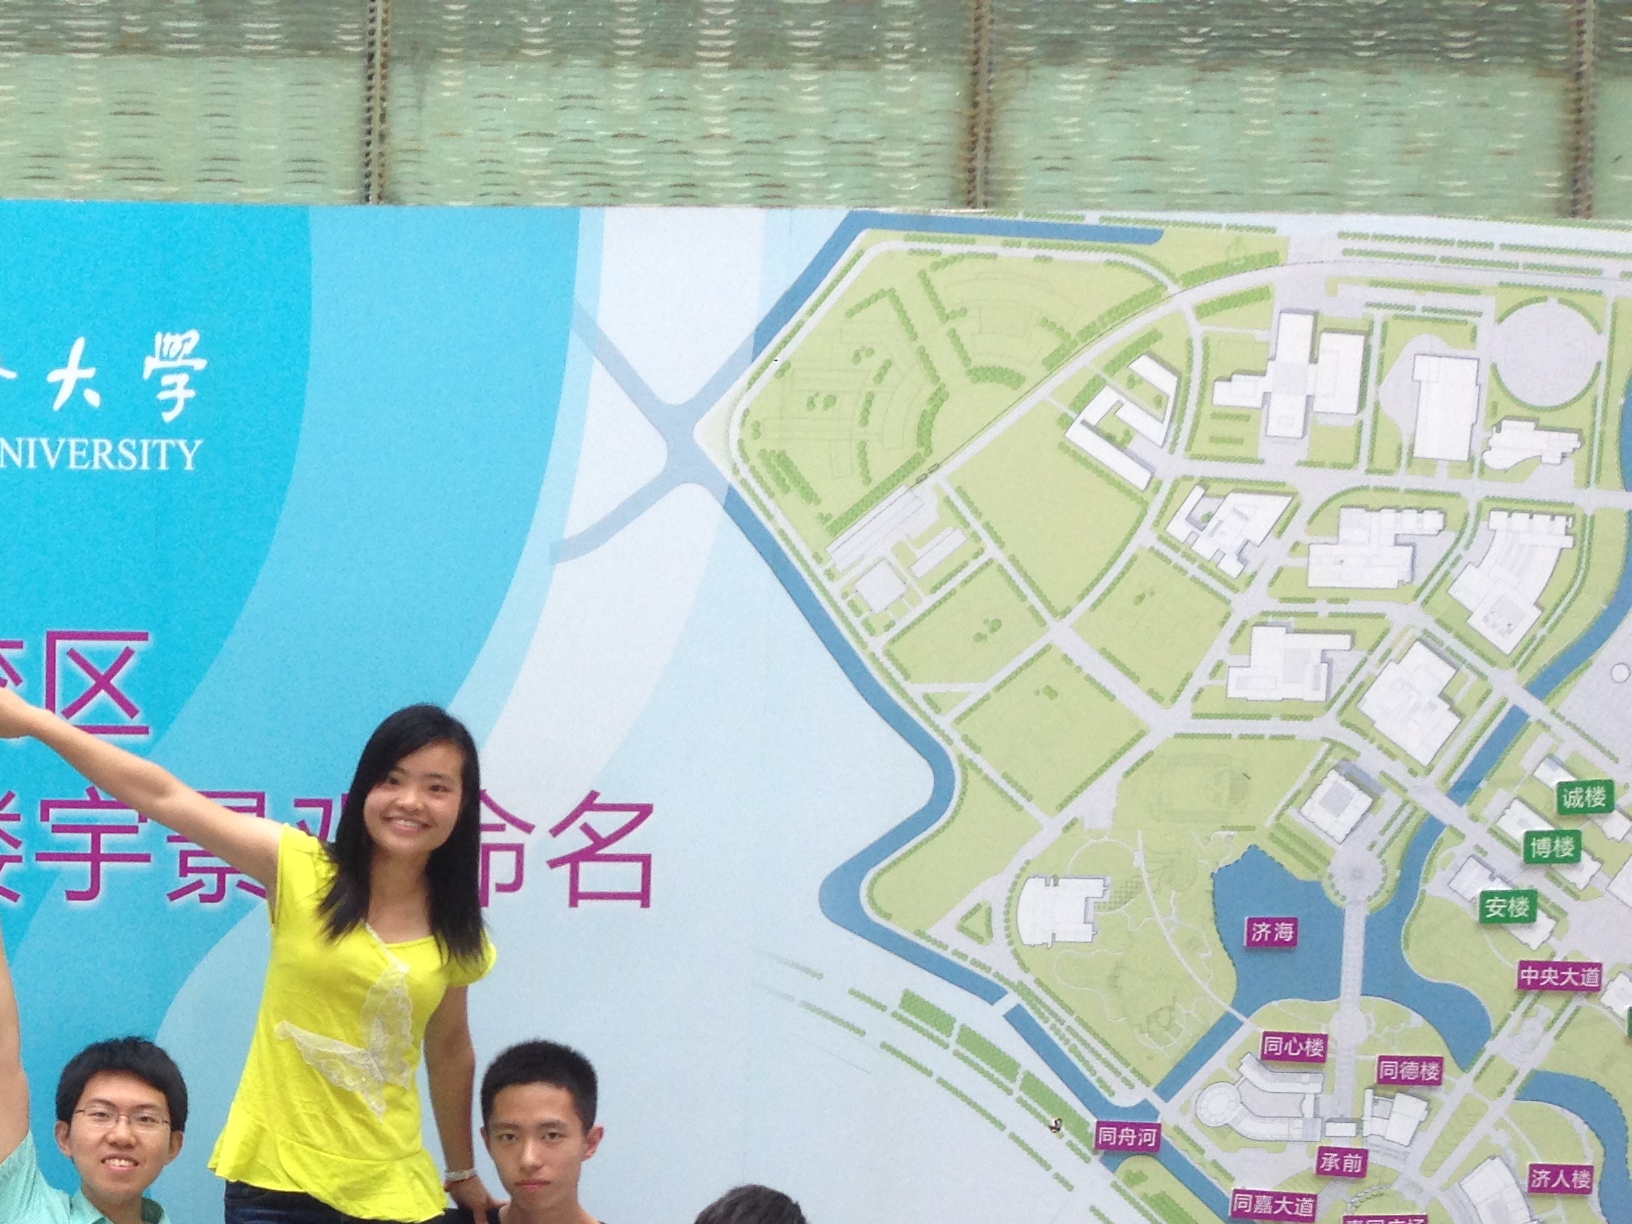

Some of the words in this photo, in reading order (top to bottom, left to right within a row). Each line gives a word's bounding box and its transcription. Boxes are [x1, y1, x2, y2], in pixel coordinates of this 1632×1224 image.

[1563, 786, 1607, 808] 诚楼
[1531, 836, 1576, 859] 博楼
[1485, 895, 1530, 918] 安楼
[1251, 921, 1295, 943] 济海
[1519, 966, 1601, 988] 中央大道
[1263, 1035, 1325, 1058] 同心楼
[1379, 1060, 1440, 1082] 同德楼
[1097, 1126, 1157, 1147] 同舟河
[1320, 1152, 1363, 1173] 承前
[1531, 1168, 1592, 1190] 济人楼
[1232, 1194, 1315, 1217] 同嘉大道
